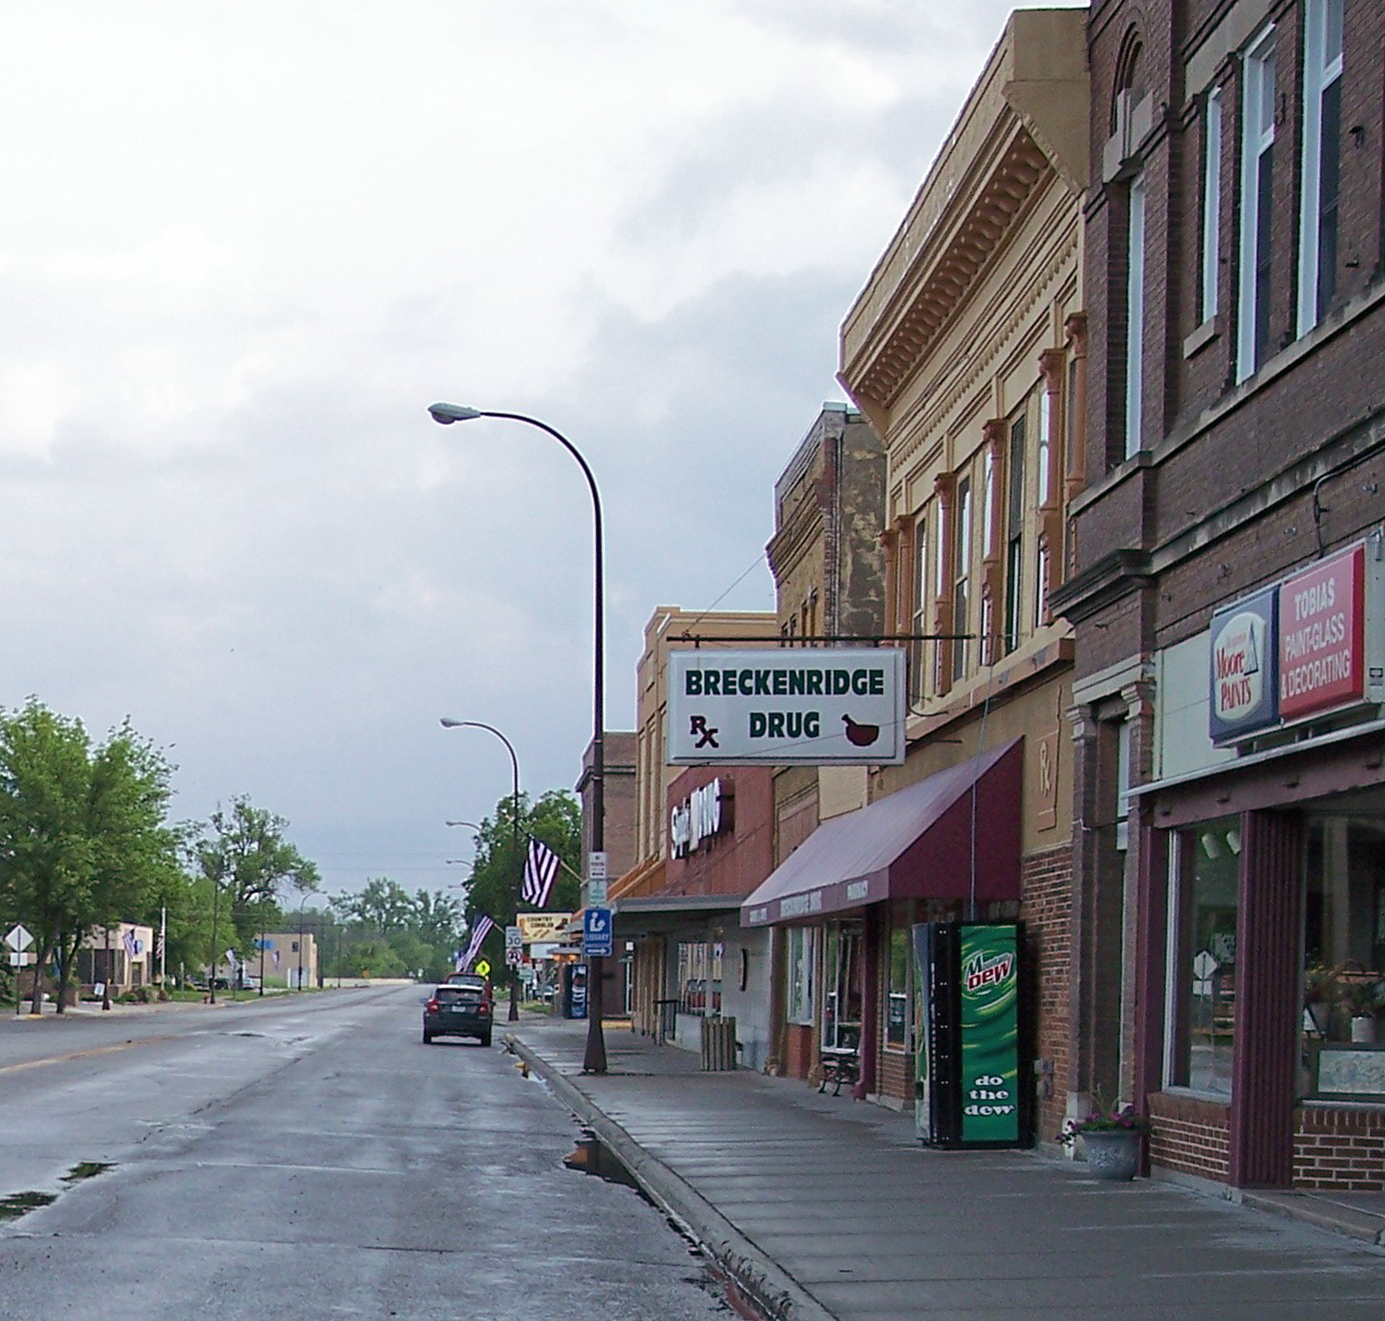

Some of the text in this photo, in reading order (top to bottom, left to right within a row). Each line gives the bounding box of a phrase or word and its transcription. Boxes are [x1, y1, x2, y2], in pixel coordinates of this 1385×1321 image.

[1294, 577, 1335, 621] TOBIAS
[1216, 646, 1246, 680] Moore
[1289, 649, 1350, 697] DECORATING
[685, 669, 884, 696] BRECKENRIDGE
[1220, 677, 1252, 712] PAINTS
[749, 711, 820, 738] DRUG
[507, 937, 521, 945] 30
[975, 1075, 1003, 1086] do
[969, 1090, 1009, 1100] the
[964, 1104, 1015, 1116] dew
